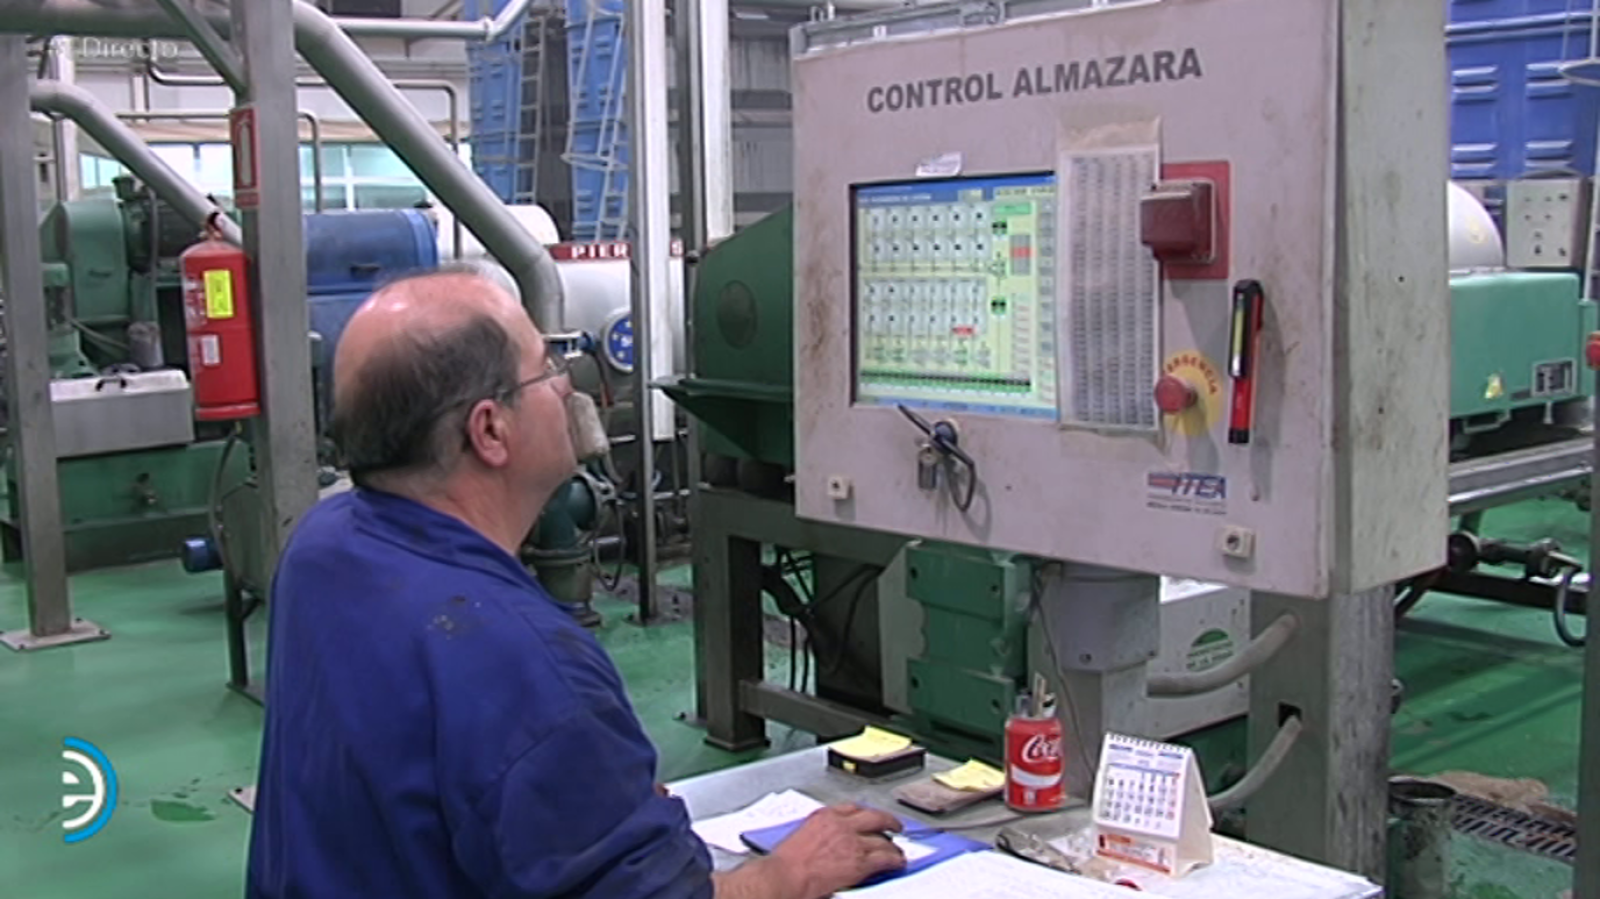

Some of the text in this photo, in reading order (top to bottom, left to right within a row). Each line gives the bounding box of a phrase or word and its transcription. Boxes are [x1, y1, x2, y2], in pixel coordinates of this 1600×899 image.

[867, 47, 1202, 113] CONTROL ALMAZARA
[1166, 353, 1218, 396] ERGENCIA
